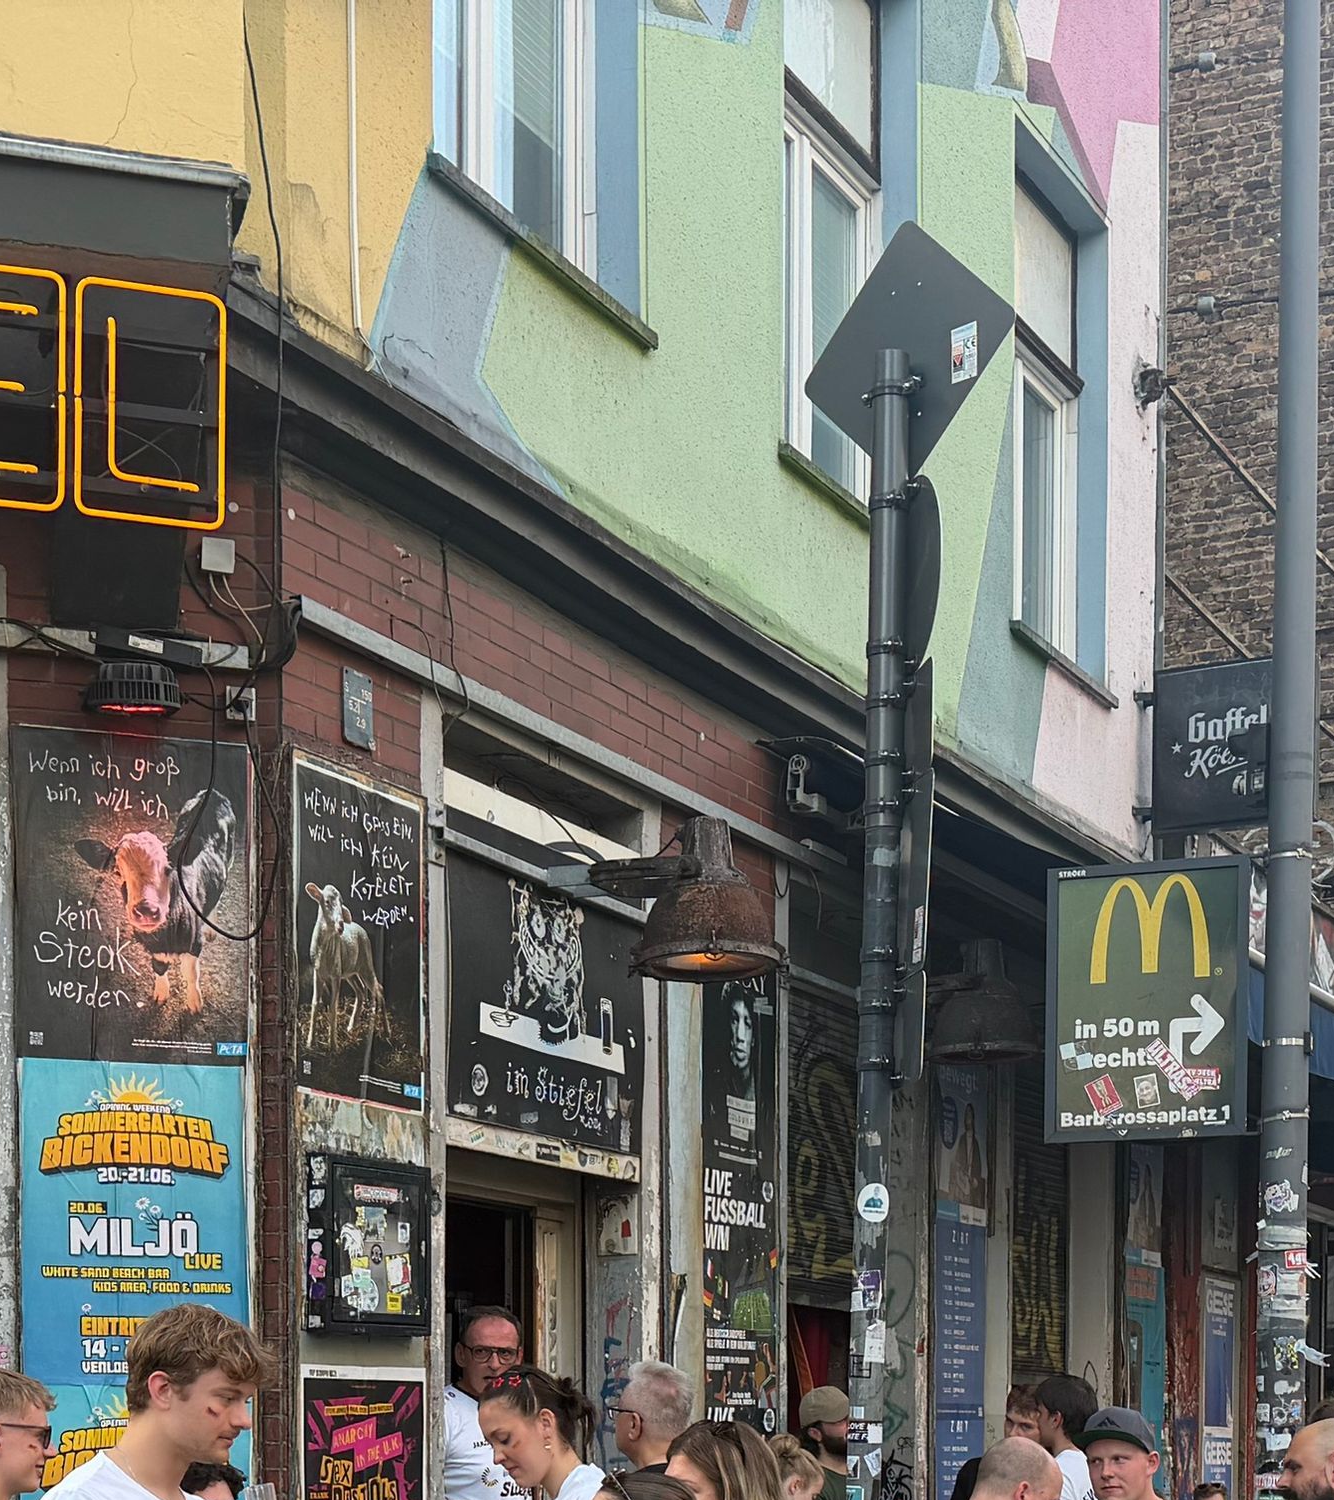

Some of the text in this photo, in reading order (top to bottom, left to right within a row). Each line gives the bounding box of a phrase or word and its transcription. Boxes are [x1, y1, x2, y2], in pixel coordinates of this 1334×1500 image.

[28, 749, 180, 785] Wenn ich groß
[46, 783, 169, 819] bin, will ich
[304, 787, 338, 818] WENN
[55, 899, 103, 931] kein
[33, 927, 141, 976] Steak
[47, 979, 145, 1009] werden.
[1074, 1016, 1160, 1040] in 50 m
[506, 1062, 603, 1121] im Stiefel
[132, 1103, 172, 1114] WEEKEND
[1221, 1104, 1231, 1123] 1
[57, 1111, 213, 1142] SOMMERGARTEN
[41, 1132, 229, 1175] BICKENDORF
[97, 1168, 176, 1186] 20.-21.06.
[704, 1167, 733, 1197] LIVE
[69, 1201, 106, 1214] 20.06.
[704, 1195, 766, 1229] FUSSBALL
[69, 1211, 199, 1258] MILJÖ
[704, 1222, 730, 1251] WM
[42, 1265, 170, 1280] WHITE SAND BEACH BAR
[184, 1252, 223, 1271] LIVE
[92, 1281, 117, 1293] KIDS
[120, 1281, 150, 1295] AREA,
[152, 1282, 180, 1294] FOOD
[192, 1283, 232, 1295] DRINKS
[82, 1339, 107, 1357] 14
